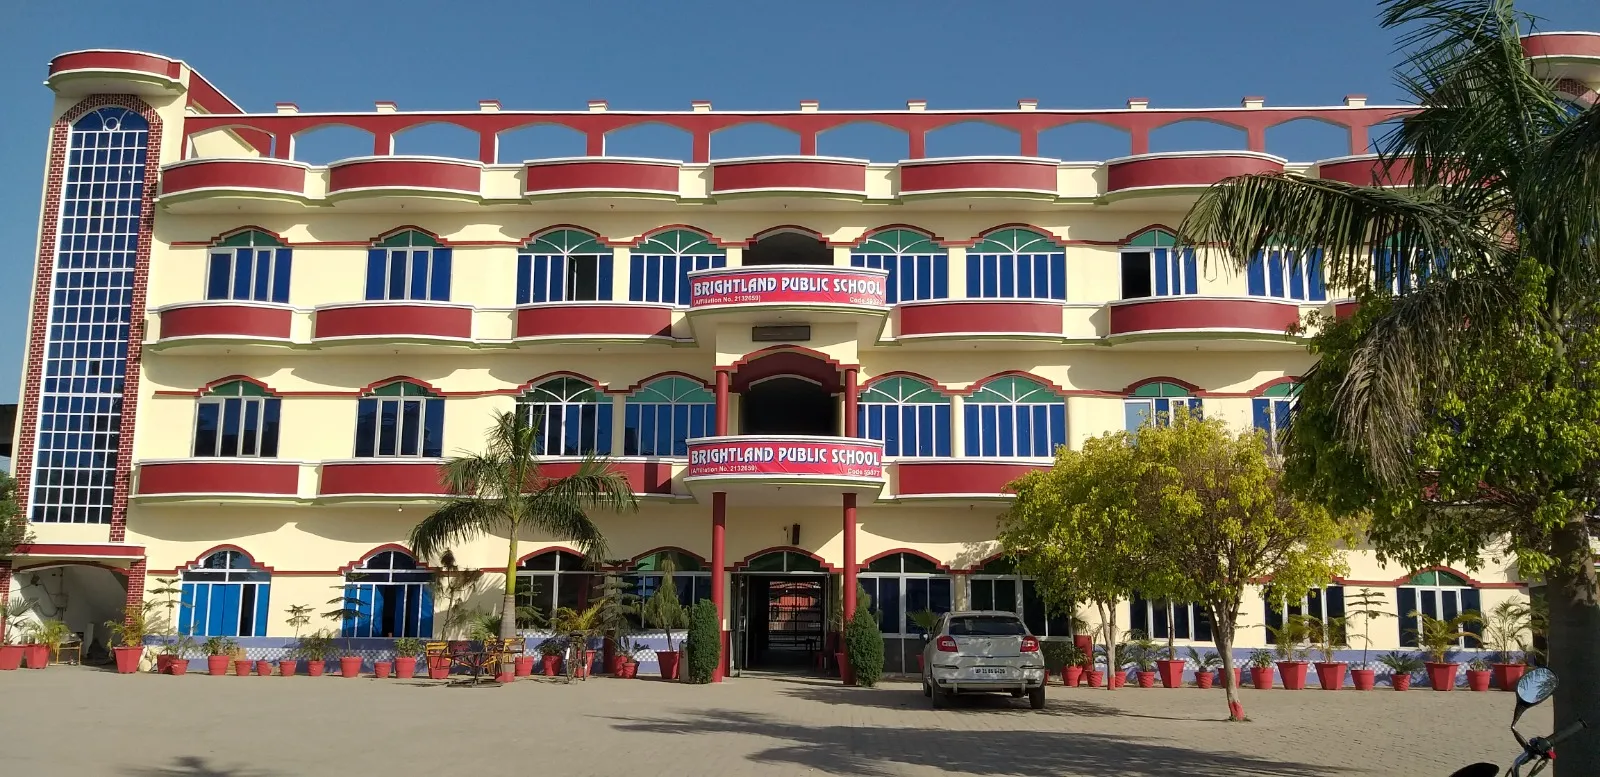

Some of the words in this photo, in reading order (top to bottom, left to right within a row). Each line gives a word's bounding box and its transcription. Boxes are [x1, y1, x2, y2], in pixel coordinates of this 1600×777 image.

[694, 277, 777, 297] BRIGHTLAND
[781, 277, 829, 292] PUBLIC
[833, 278, 883, 296] SCHOOL
[849, 296, 865, 304] Code
[691, 447, 774, 465] BRIGHTLAND
[779, 447, 827, 463] PUBLIC
[831, 449, 880, 467] SCHOOL
[847, 467, 862, 475] Code
